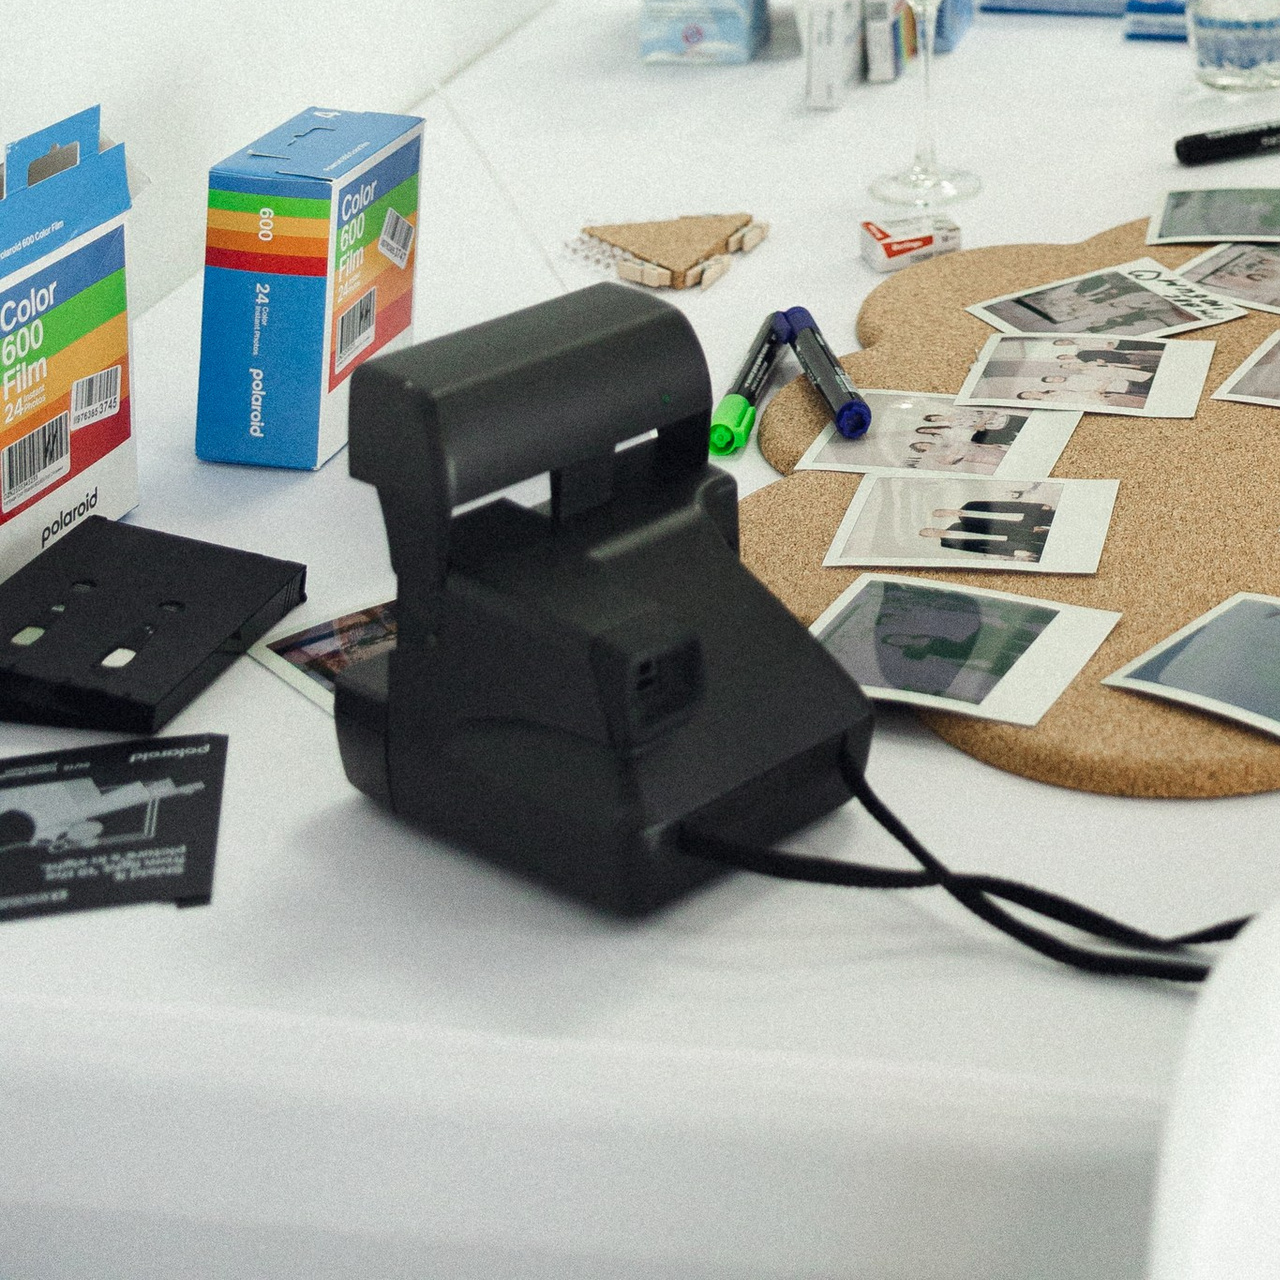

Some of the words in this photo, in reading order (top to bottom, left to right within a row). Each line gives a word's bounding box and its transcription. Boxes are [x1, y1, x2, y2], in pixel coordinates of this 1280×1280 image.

[341, 180, 378, 221] Color
[0, 239, 22, 260] olaroid
[21, 234, 35, 248] 600
[34, 226, 52, 242] Color
[51, 220, 65, 233] Film
[257, 207, 275, 242] 600
[340, 212, 366, 252] 600
[339, 246, 365, 284] Film
[0, 280, 58, 332] Color
[255, 282, 271, 305] 24
[253, 305, 262, 330] Instant
[261, 306, 270, 327] Color
[2, 318, 44, 366] 600
[252, 330, 261, 356] Photos
[3, 357, 47, 401] Film
[23, 384, 45, 402] Instant
[4, 397, 24, 424] 24
[23, 394, 46, 413] Photos
[99, 396, 118, 415] 3745
[249, 367, 267, 439] polaroid
[41, 486, 98, 549] polaroid
[129, 743, 211, 764] polaroid
